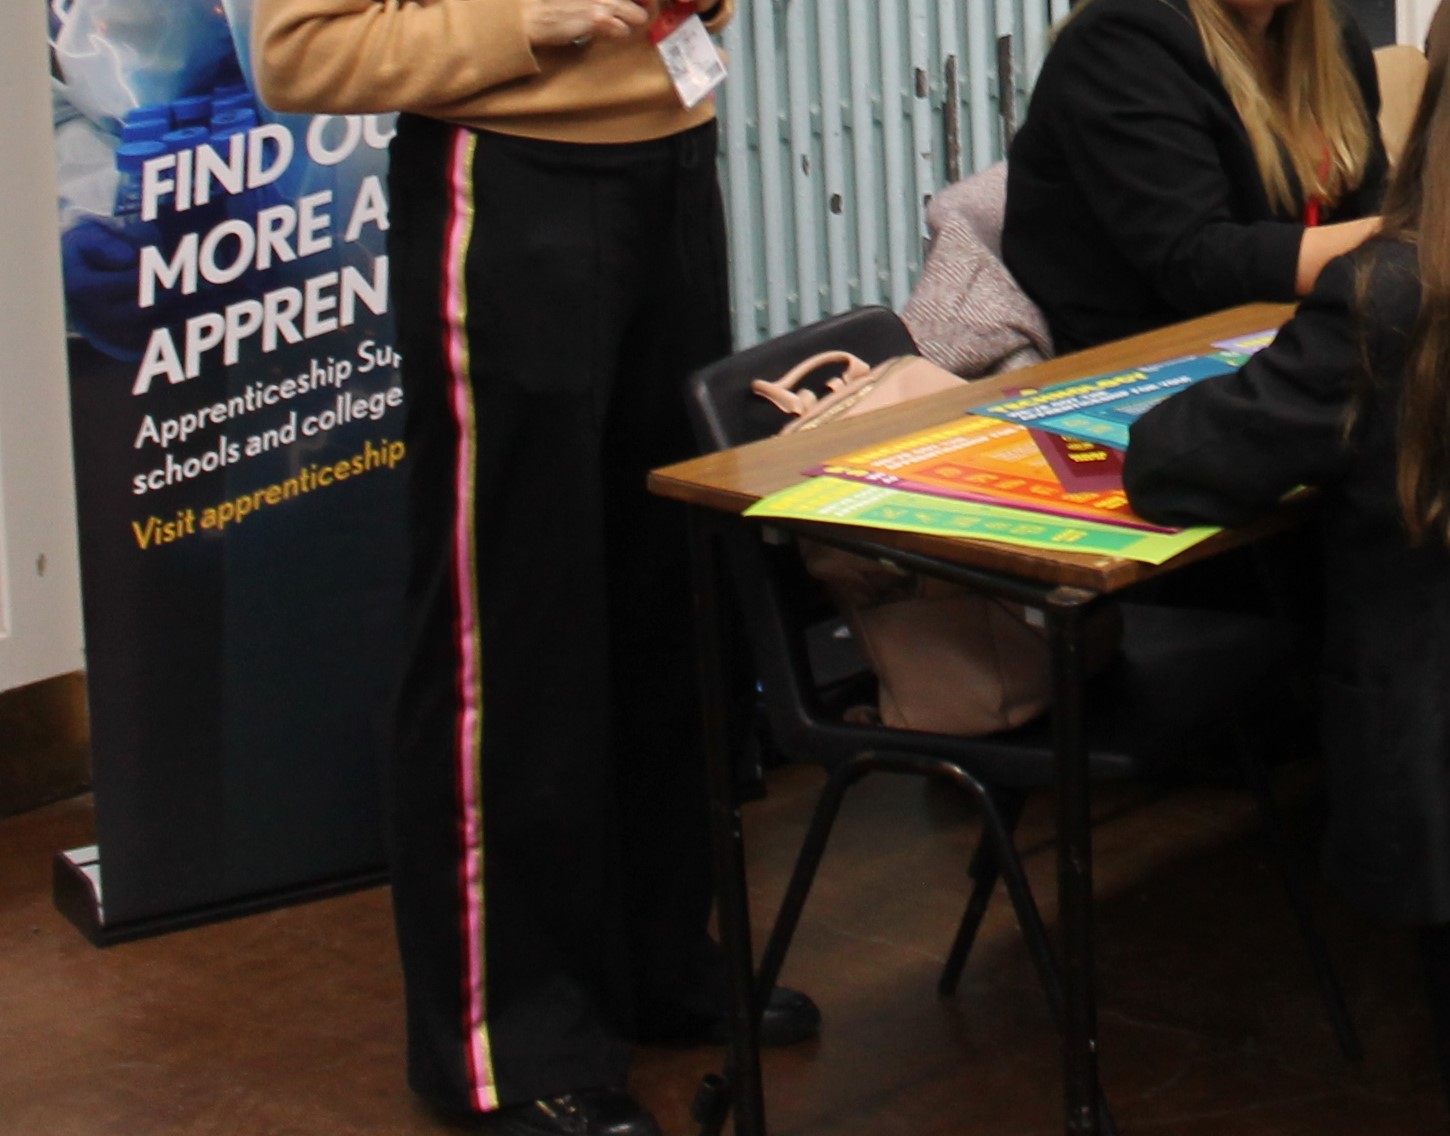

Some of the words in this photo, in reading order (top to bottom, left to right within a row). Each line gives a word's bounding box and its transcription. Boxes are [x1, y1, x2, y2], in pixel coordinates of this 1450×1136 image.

[141, 123, 294, 222] FIND
[138, 190, 332, 309] MORE
[345, 175, 390, 242] A
[132, 255, 389, 395] APPREN
[132, 437, 240, 495] schools
[245, 414, 297, 457] and
[302, 386, 403, 439] college
[134, 356, 352, 449] Apprenticeship
[132, 509, 196, 550] Visit
[200, 439, 406, 532] apprenticeship
